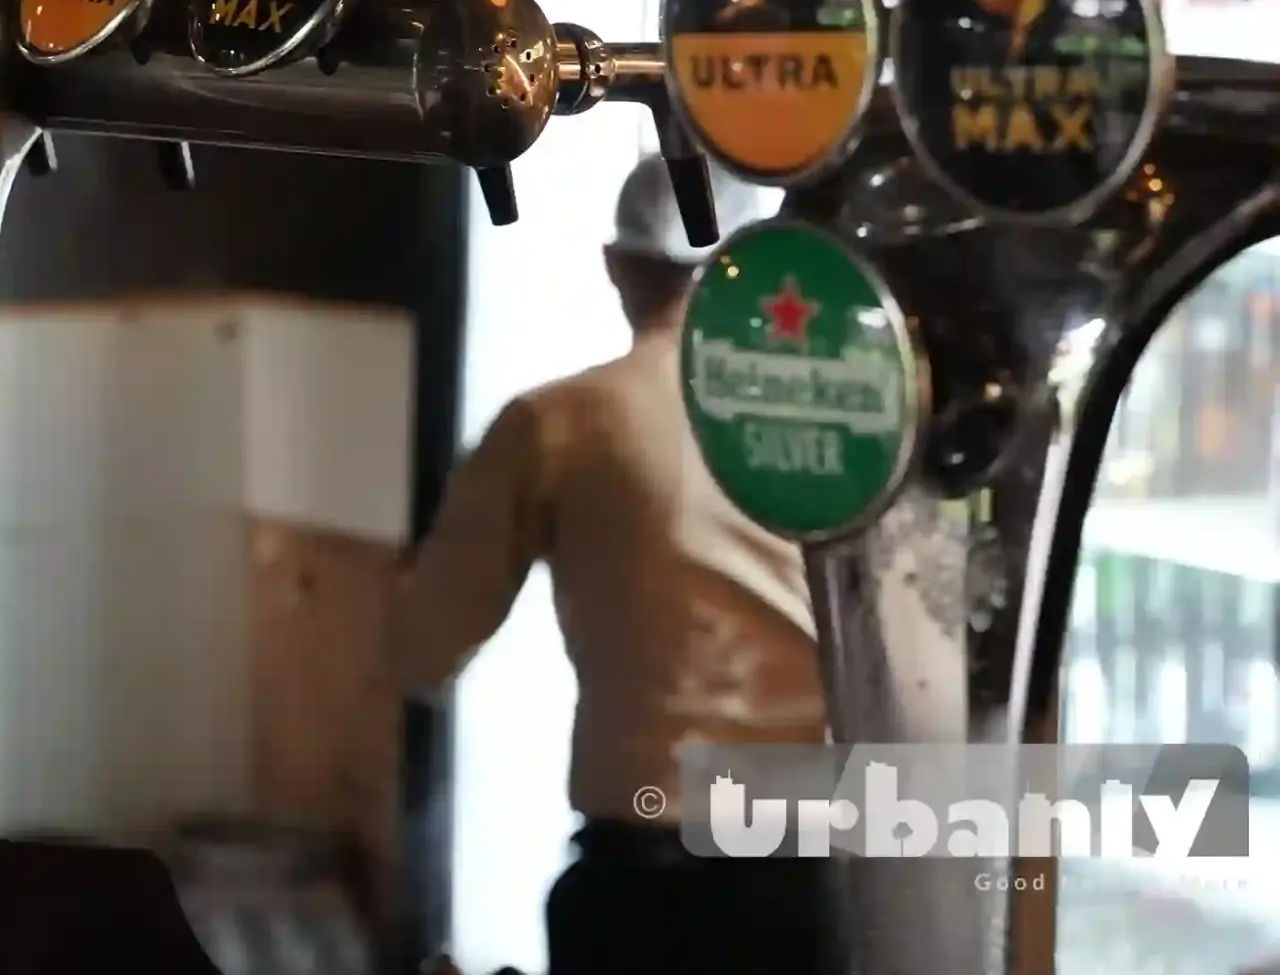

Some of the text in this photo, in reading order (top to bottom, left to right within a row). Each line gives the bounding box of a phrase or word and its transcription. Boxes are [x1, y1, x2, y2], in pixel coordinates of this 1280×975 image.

[690, 53, 839, 91] ULTRA
[950, 65, 1098, 99] ULTRA
[951, 102, 1096, 153] MAX
[743, 422, 846, 476] SILVER
